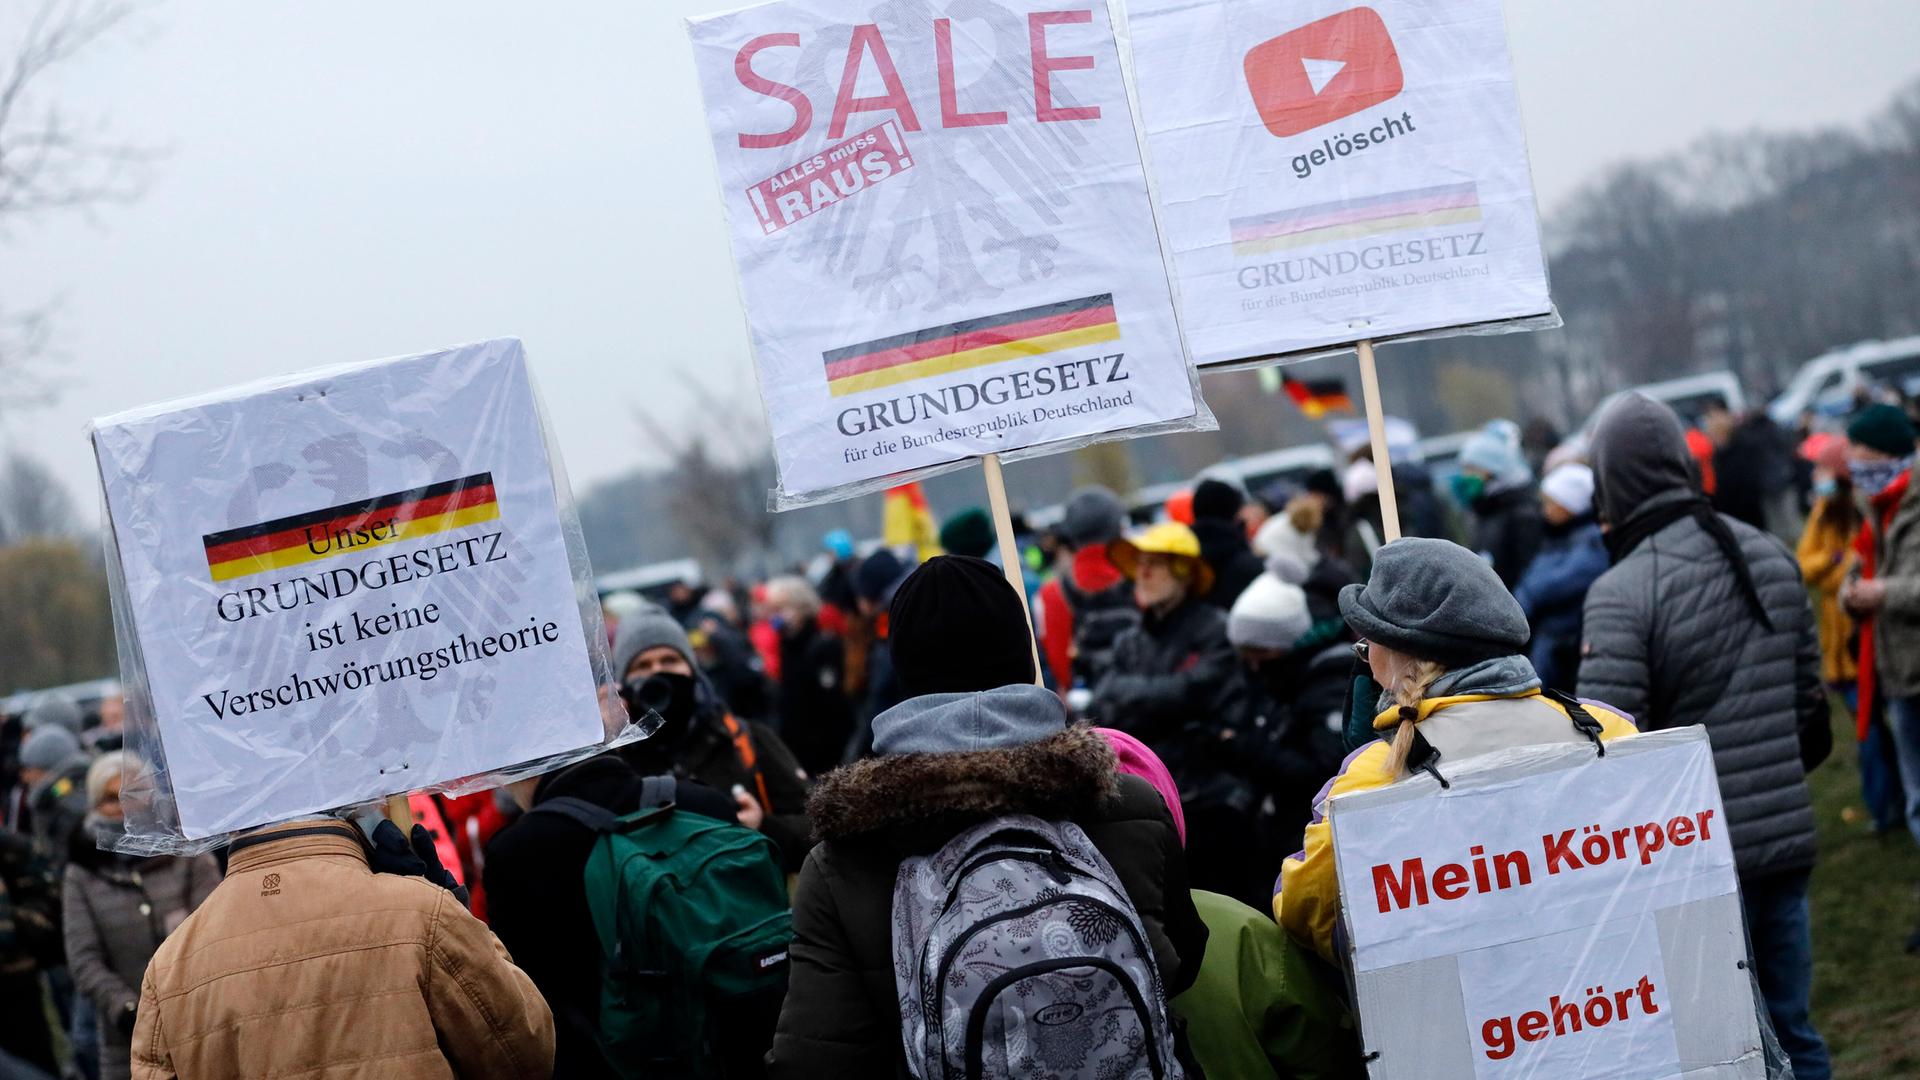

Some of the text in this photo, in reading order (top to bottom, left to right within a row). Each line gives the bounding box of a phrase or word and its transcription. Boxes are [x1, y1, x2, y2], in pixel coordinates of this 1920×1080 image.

[734, 9, 1101, 149] SALE
[769, 133, 877, 192] ALLES muss
[1290, 110, 1416, 179] gelöscht
[1236, 231, 1488, 290] GRUNDGESETZ
[1241, 263, 1490, 312] für die Bundesrepublik Deutschland
[836, 352, 1129, 437] GRUNDGESETZ
[844, 390, 1134, 463] für die Bundesrepublik Deutschland
[304, 516, 400, 556] Unser
[216, 532, 508, 623] GRUNDGESETZ
[304, 599, 441, 653] ist keine
[202, 616, 560, 721] Verschwörungstheorie
[1371, 808, 1714, 914] Mein Körper
[1481, 974, 1660, 1061] gehört
